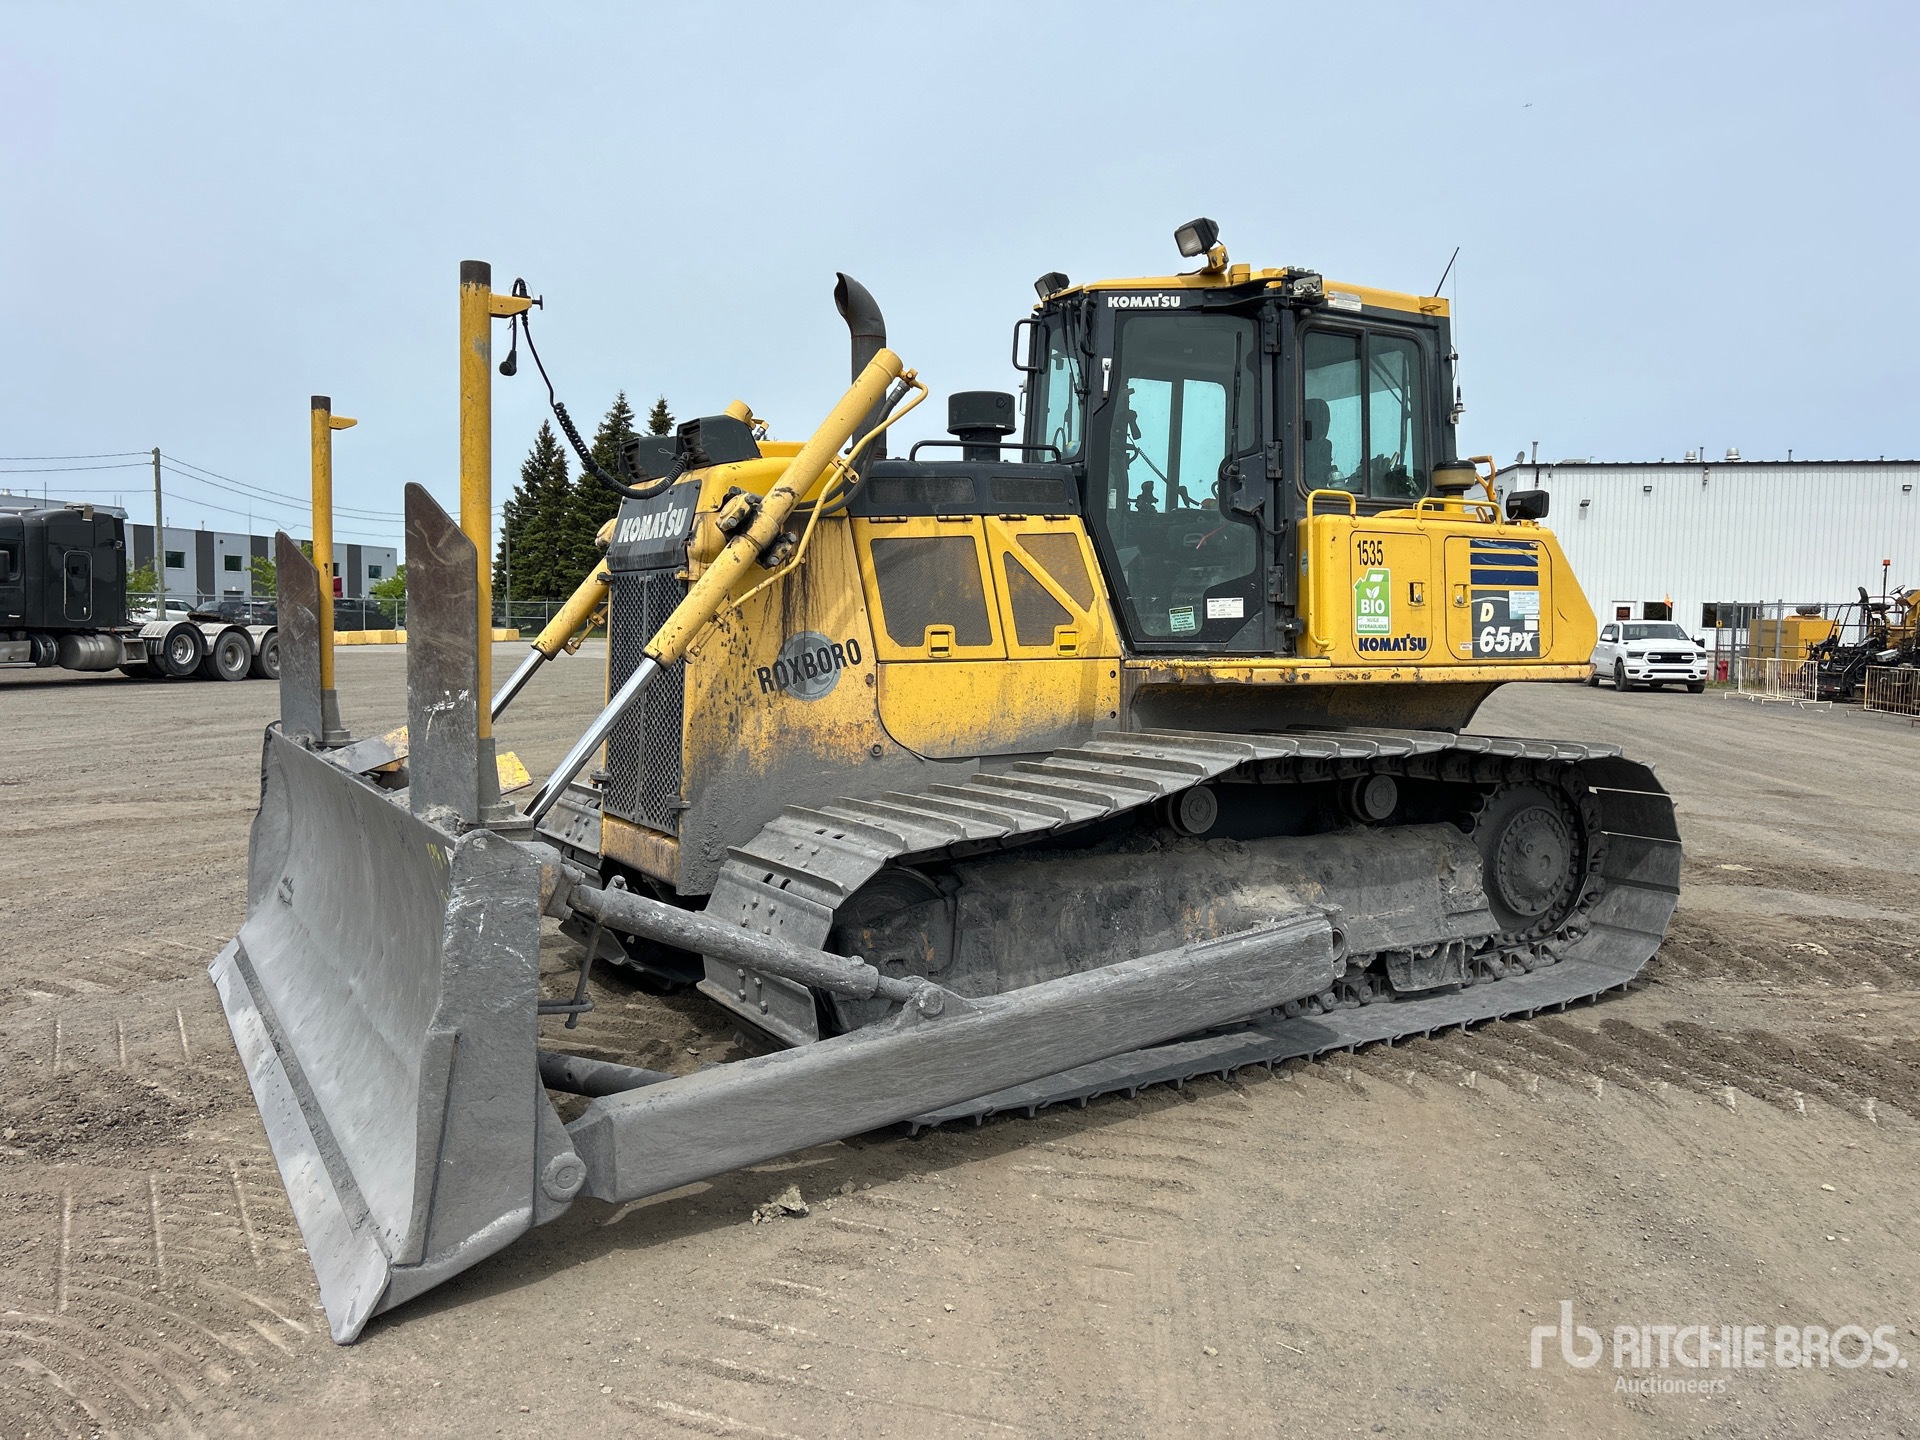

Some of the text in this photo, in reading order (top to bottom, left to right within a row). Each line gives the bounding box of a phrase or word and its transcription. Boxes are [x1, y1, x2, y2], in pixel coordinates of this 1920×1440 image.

[1108, 293, 1180, 308] KOMATSU
[617, 502, 688, 543] KOMATSU
[1357, 540, 1384, 566] 1535
[1361, 599, 1385, 614] BIO
[1480, 602, 1495, 623] D
[1358, 633, 1427, 652] KOMATSU
[1480, 626, 1535, 653] 65PX
[756, 638, 862, 695] ROXBORO
